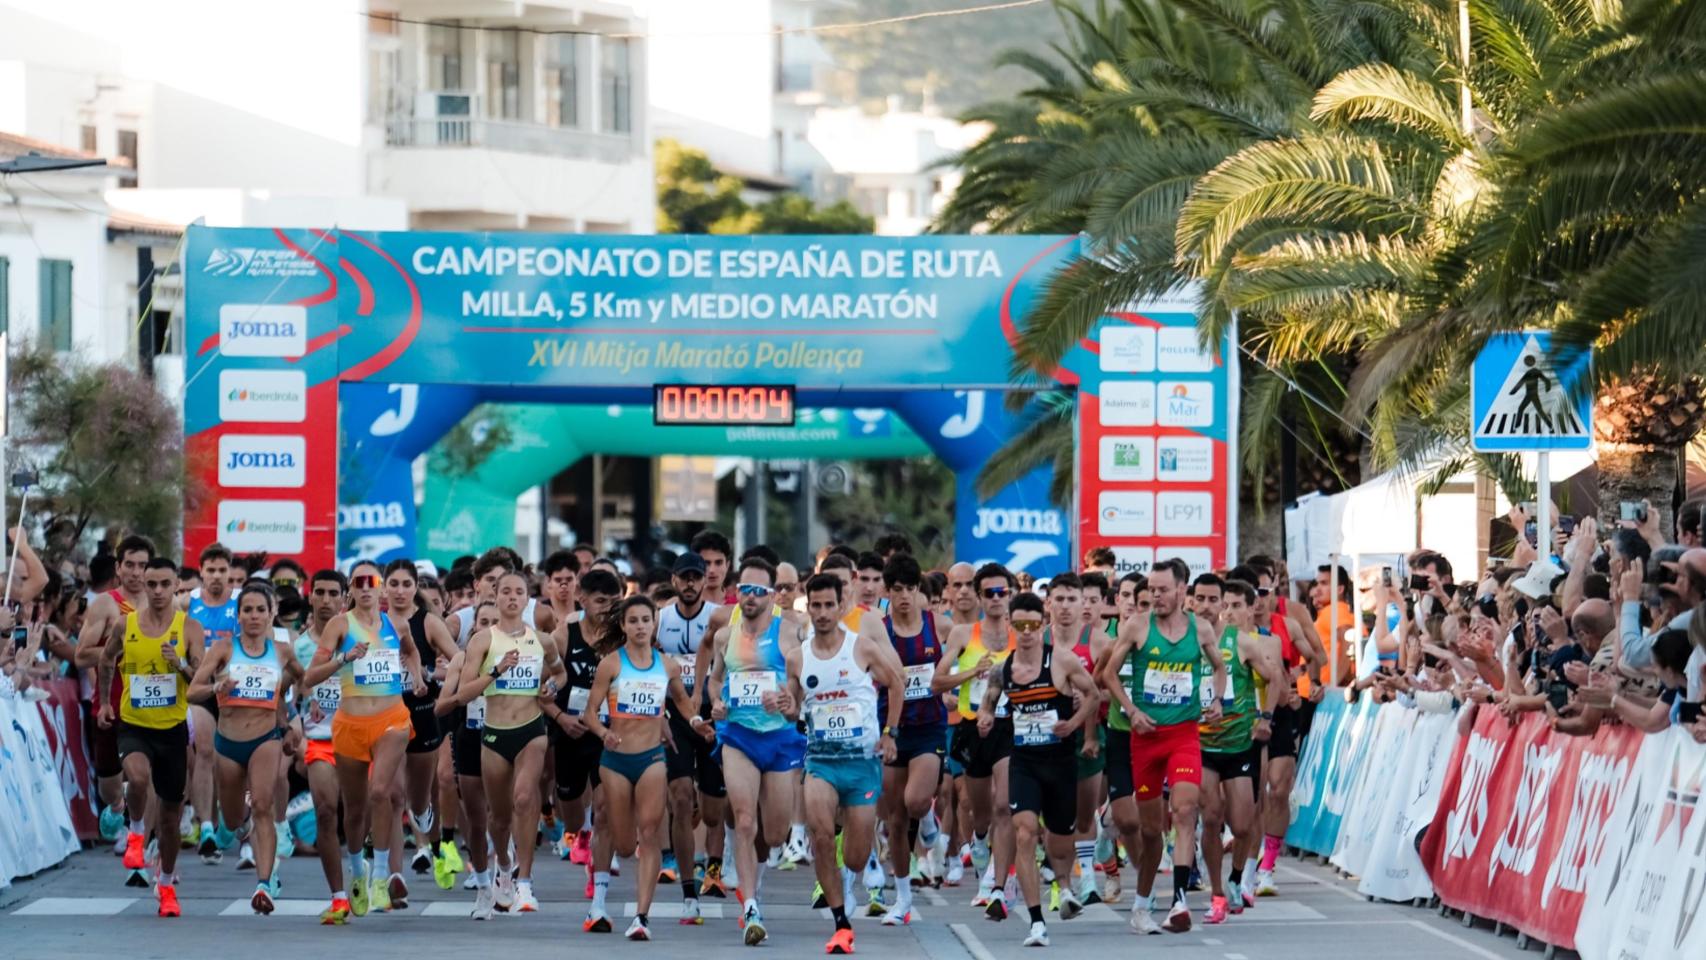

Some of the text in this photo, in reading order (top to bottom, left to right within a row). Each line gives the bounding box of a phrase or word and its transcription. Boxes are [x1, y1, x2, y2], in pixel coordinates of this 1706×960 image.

[413, 244, 1002, 278] CAMPEONATO DE ESPAÑA DE RUTA
[462, 289, 937, 323] MILLA, 5 Km y MEDIO MARATÓN
[528, 340, 863, 374] XVI Mitja Marató Pollença
[1169, 401, 1200, 416] Mar
[727, 428, 839, 442] pollensa.com
[339, 502, 406, 529] oma
[1164, 504, 1202, 520] LF91
[1115, 558, 1149, 572] abot
[367, 661, 390, 673] 104
[509, 666, 533, 678] 106
[245, 676, 262, 688] 85
[144, 686, 161, 697] 56
[317, 687, 340, 699] 625
[743, 683, 759, 696] 57
[904, 688, 929, 697] oma
[1160, 684, 1178, 695] 64
[631, 692, 655, 705] 105
[828, 716, 846, 729] 60
